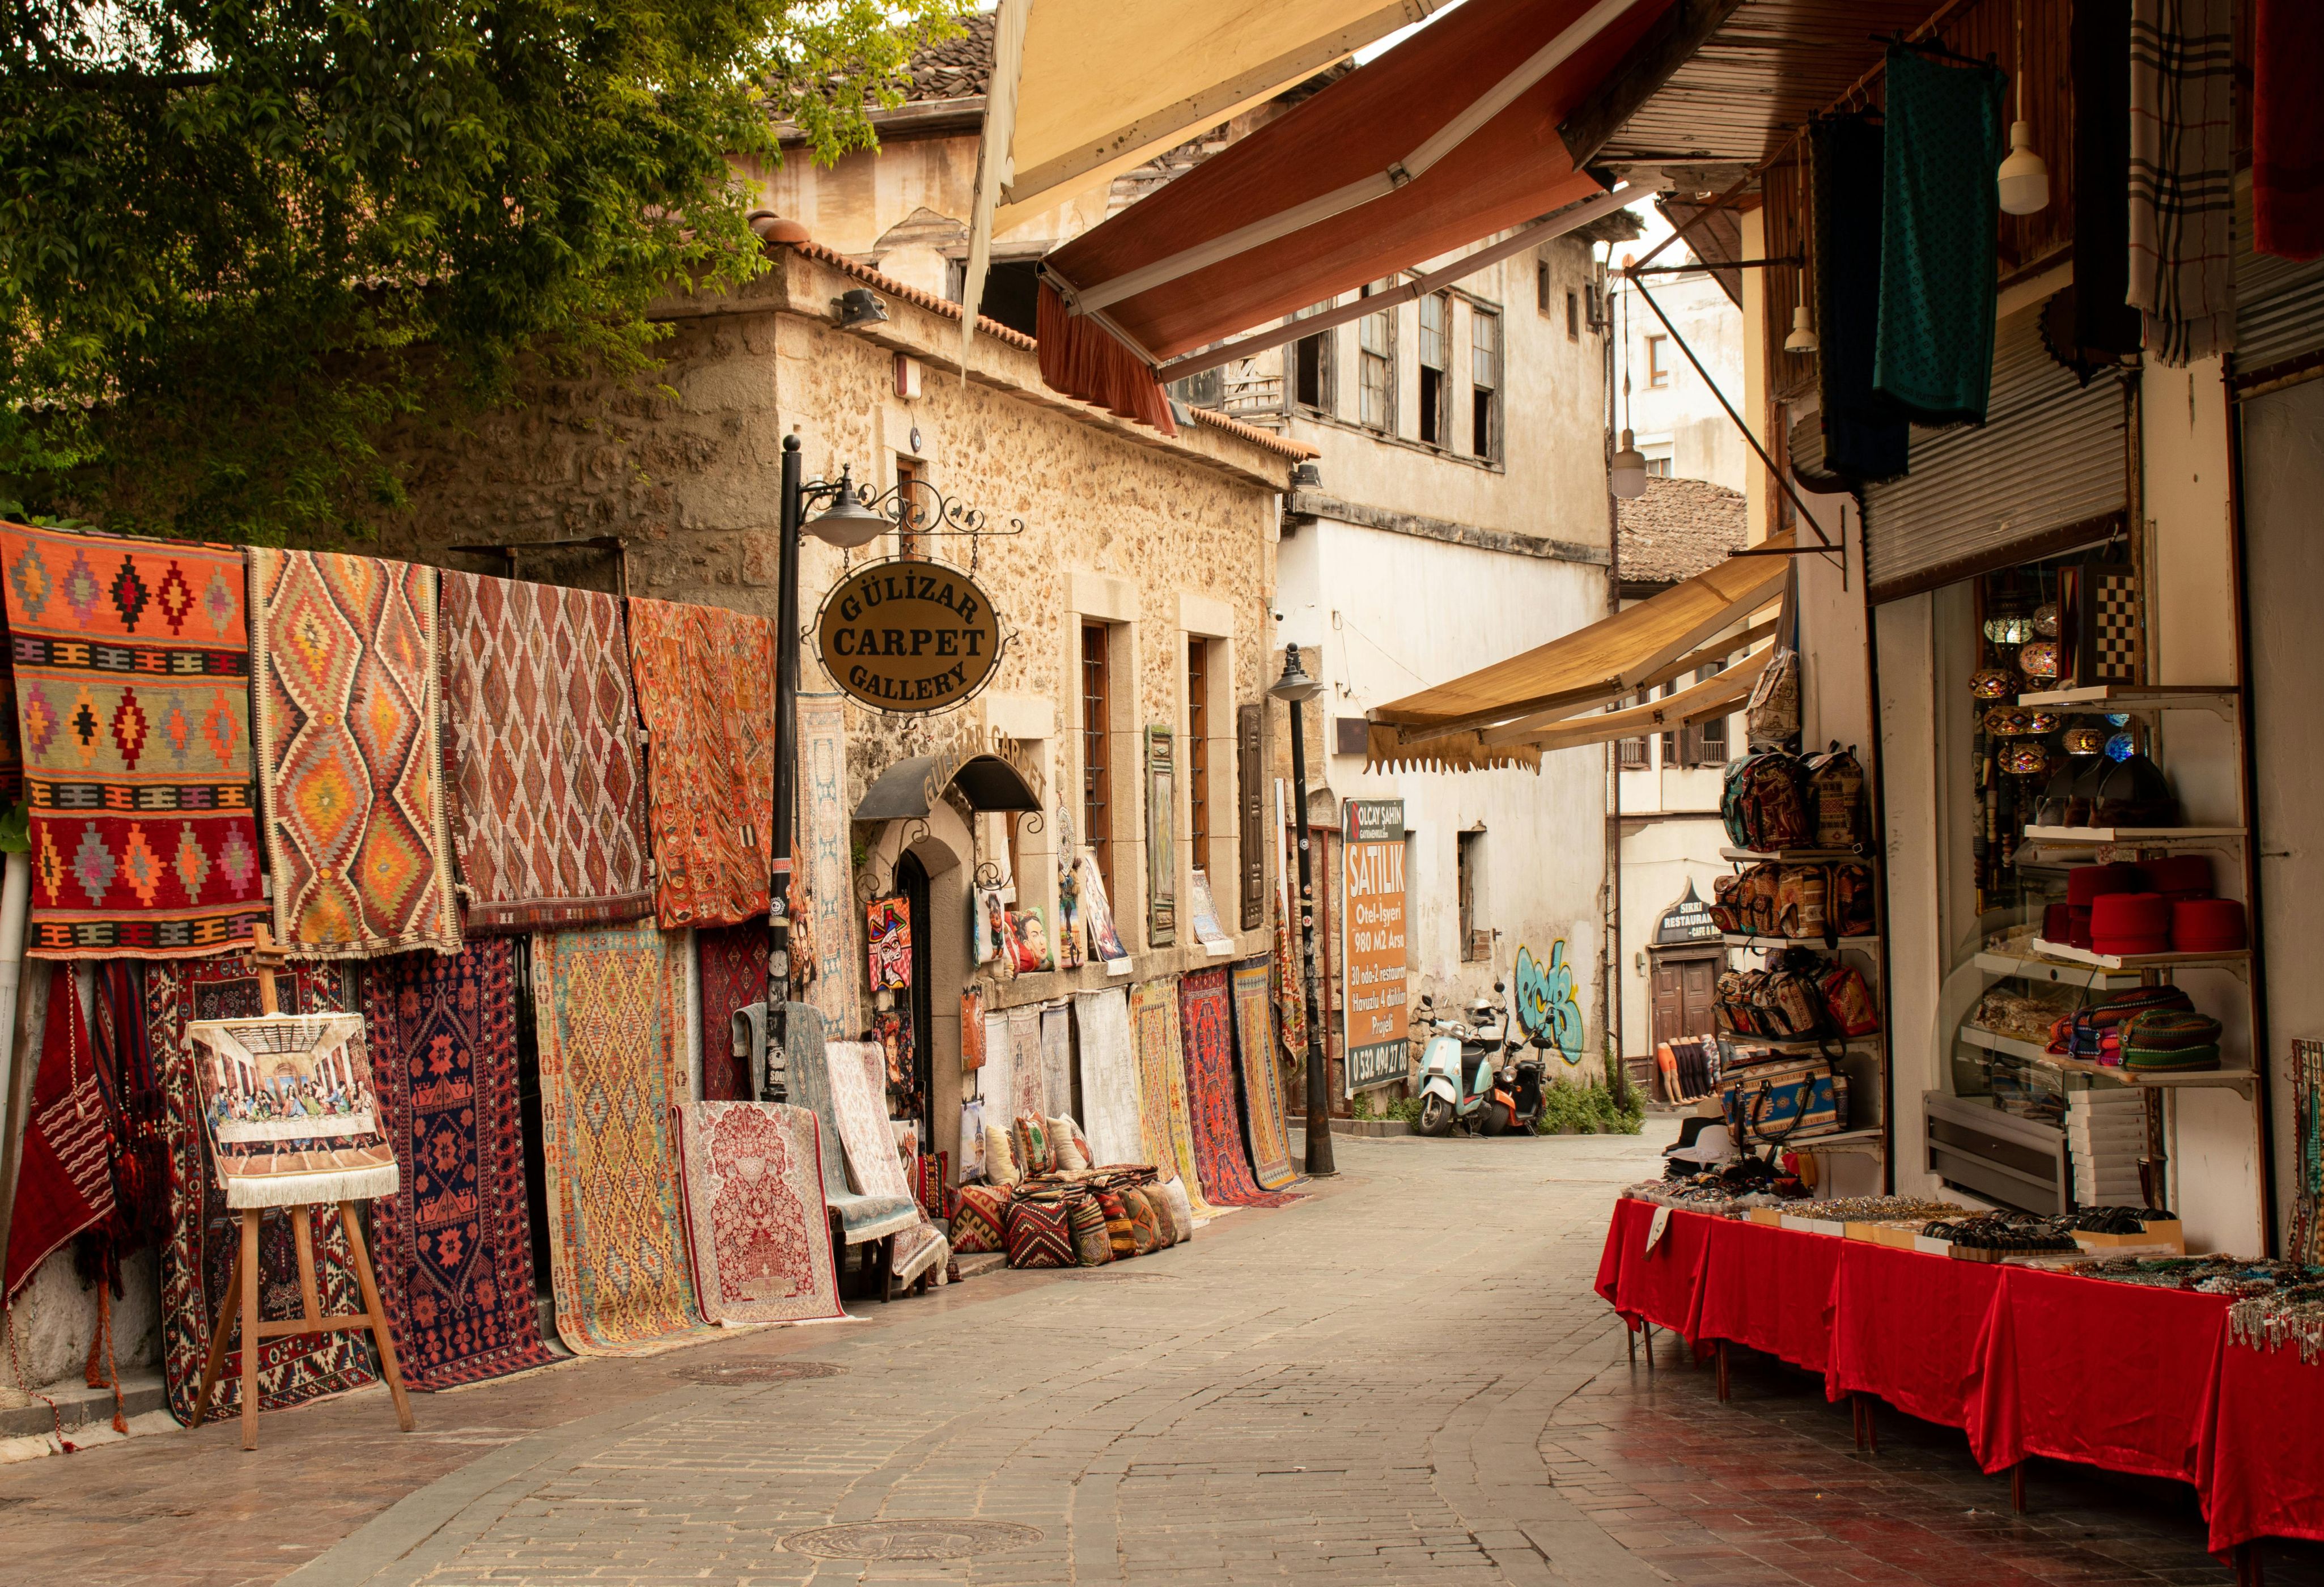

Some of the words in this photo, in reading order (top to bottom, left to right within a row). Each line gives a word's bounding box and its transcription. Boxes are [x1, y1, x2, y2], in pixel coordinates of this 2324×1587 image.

[841, 569, 978, 625] GÜLİZAR
[833, 628, 985, 656] CARPET
[849, 661, 968, 701] GALLERY
[991, 725, 1047, 801] CARPET
[1358, 806, 1380, 826] OLCAY
[1381, 802, 1402, 829] ŞAHİN
[1350, 844, 1405, 898] SATILIK
[1356, 897, 1401, 927] Otel-İşyeri
[1664, 913, 1713, 928] RESTAURAN
[1355, 931, 1371, 953] 980
[1373, 930, 1386, 951] M2
[1388, 930, 1404, 949] Arsa
[1706, 926, 1711, 936] &
[1351, 965, 1359, 986] 30
[1361, 963, 1379, 985] oda-2
[1352, 990, 1379, 1012] Havuzlu
[1380, 988, 1385, 1008] 4
[1386, 986, 1406, 1007] dükkan
[1372, 1013, 1393, 1038] Projeli
[1353, 1051, 1358, 1081] 0
[1360, 1049, 1374, 1080] 532
[1376, 1046, 1389, 1076] 494
[1399, 1041, 1407, 1072] 68
